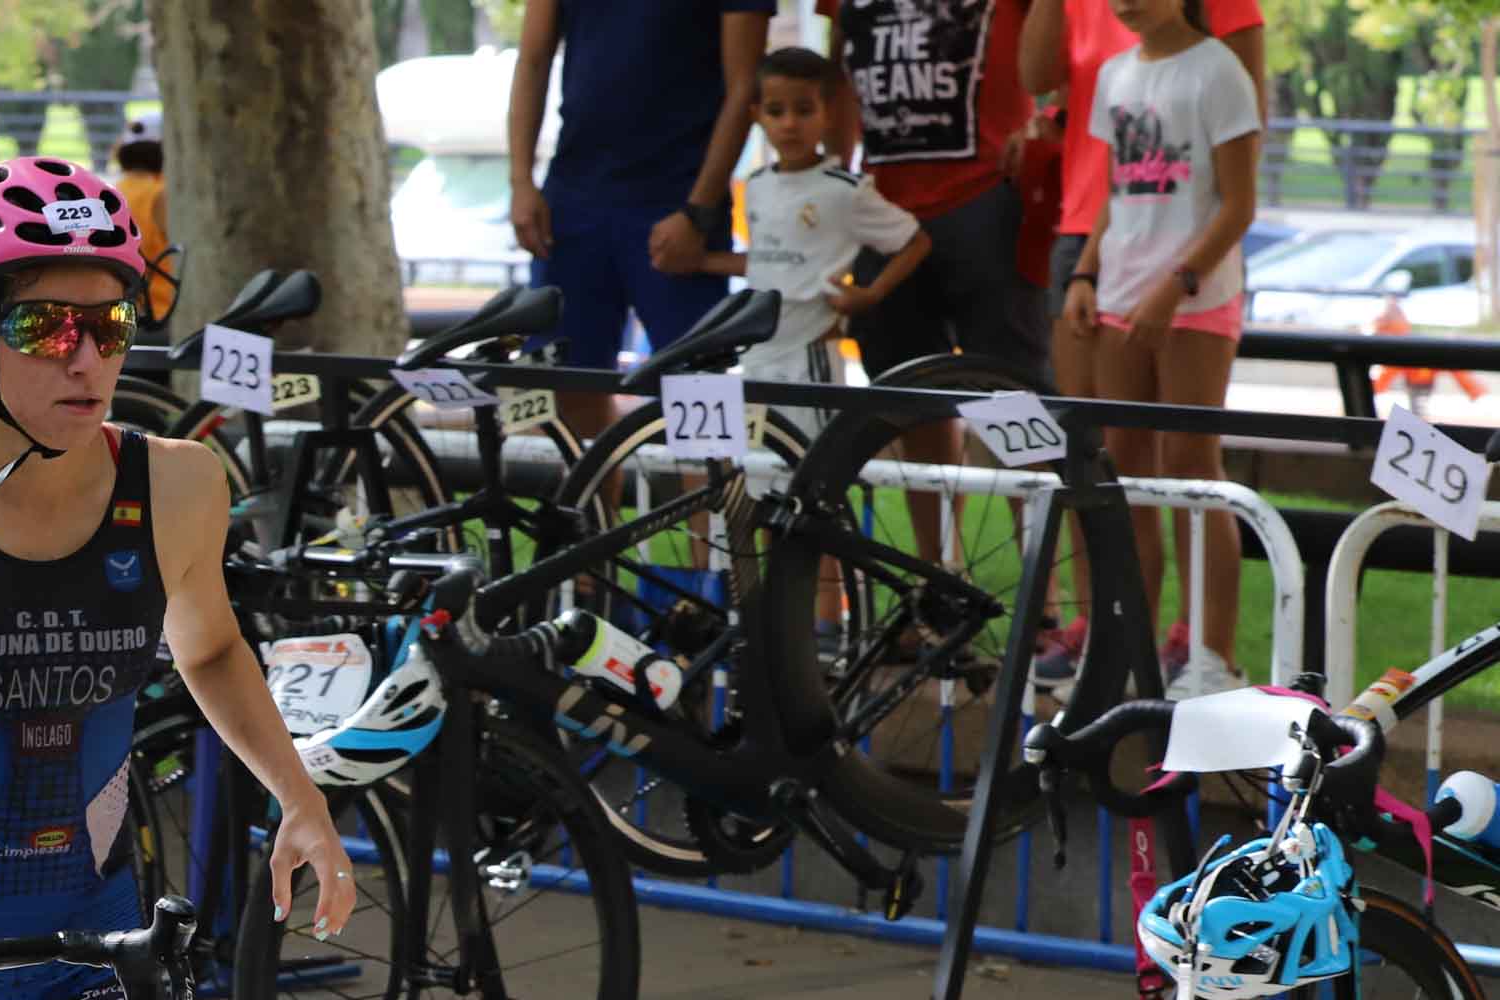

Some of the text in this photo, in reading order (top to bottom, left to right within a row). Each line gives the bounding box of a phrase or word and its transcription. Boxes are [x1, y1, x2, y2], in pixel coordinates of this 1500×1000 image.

[872, 18, 931, 62] THE
[56, 206, 93, 221] 229
[211, 345, 261, 390] 223
[510, 395, 549, 422] 222
[671, 400, 733, 440] 221
[986, 416, 1061, 454] 220
[1388, 429, 1470, 505] 219
[16, 608, 87, 629] C. D. T.
[44, 631, 75, 653] DE
[79, 626, 147, 653] DUERO
